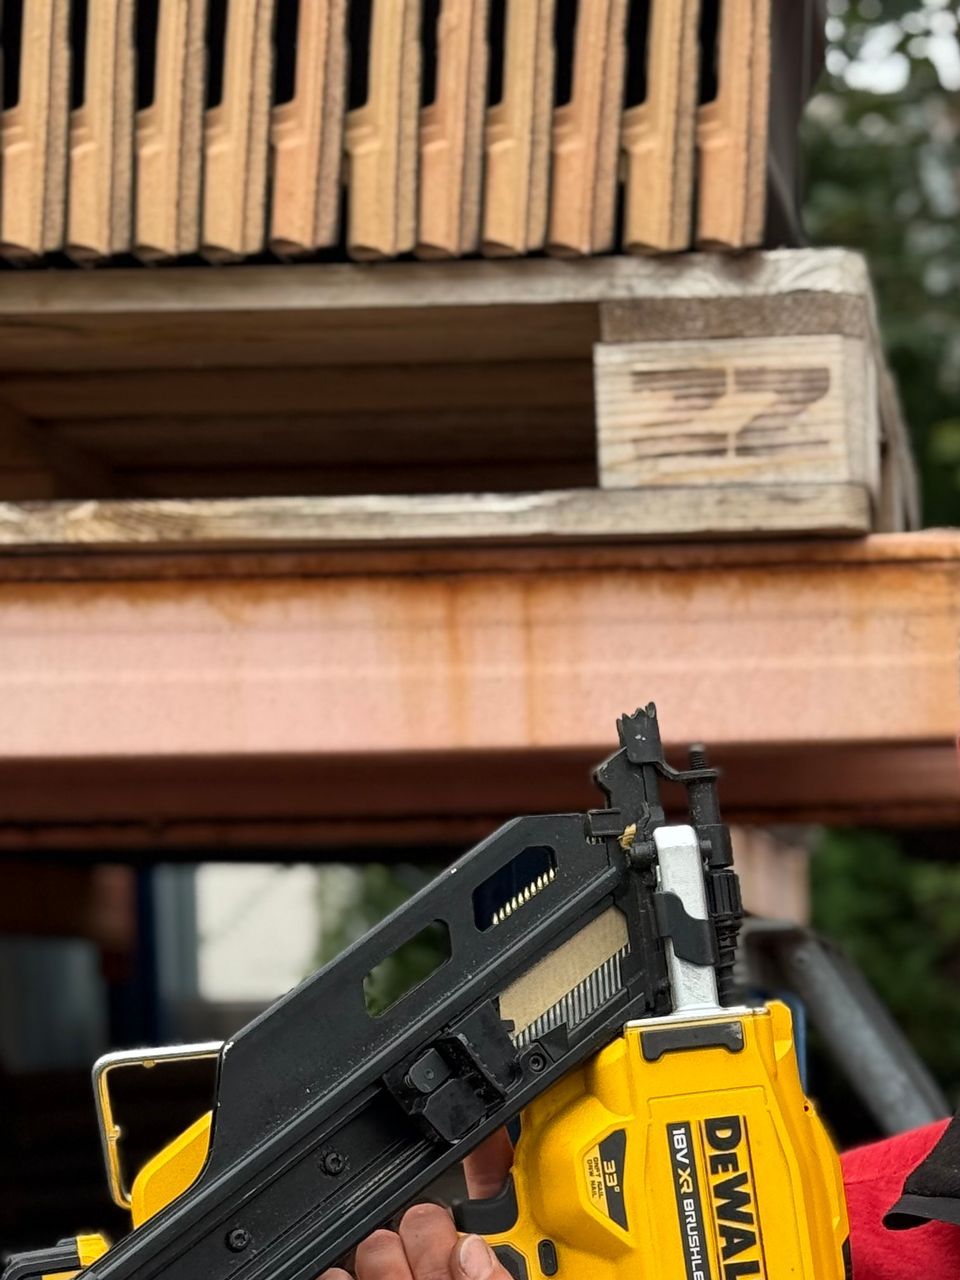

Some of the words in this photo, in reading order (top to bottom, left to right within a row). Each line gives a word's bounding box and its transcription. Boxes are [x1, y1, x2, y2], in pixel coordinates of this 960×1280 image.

[672, 1128, 690, 1164] 18V
[603, 1160, 620, 1192] 33°
[678, 1168, 694, 1194] XR
